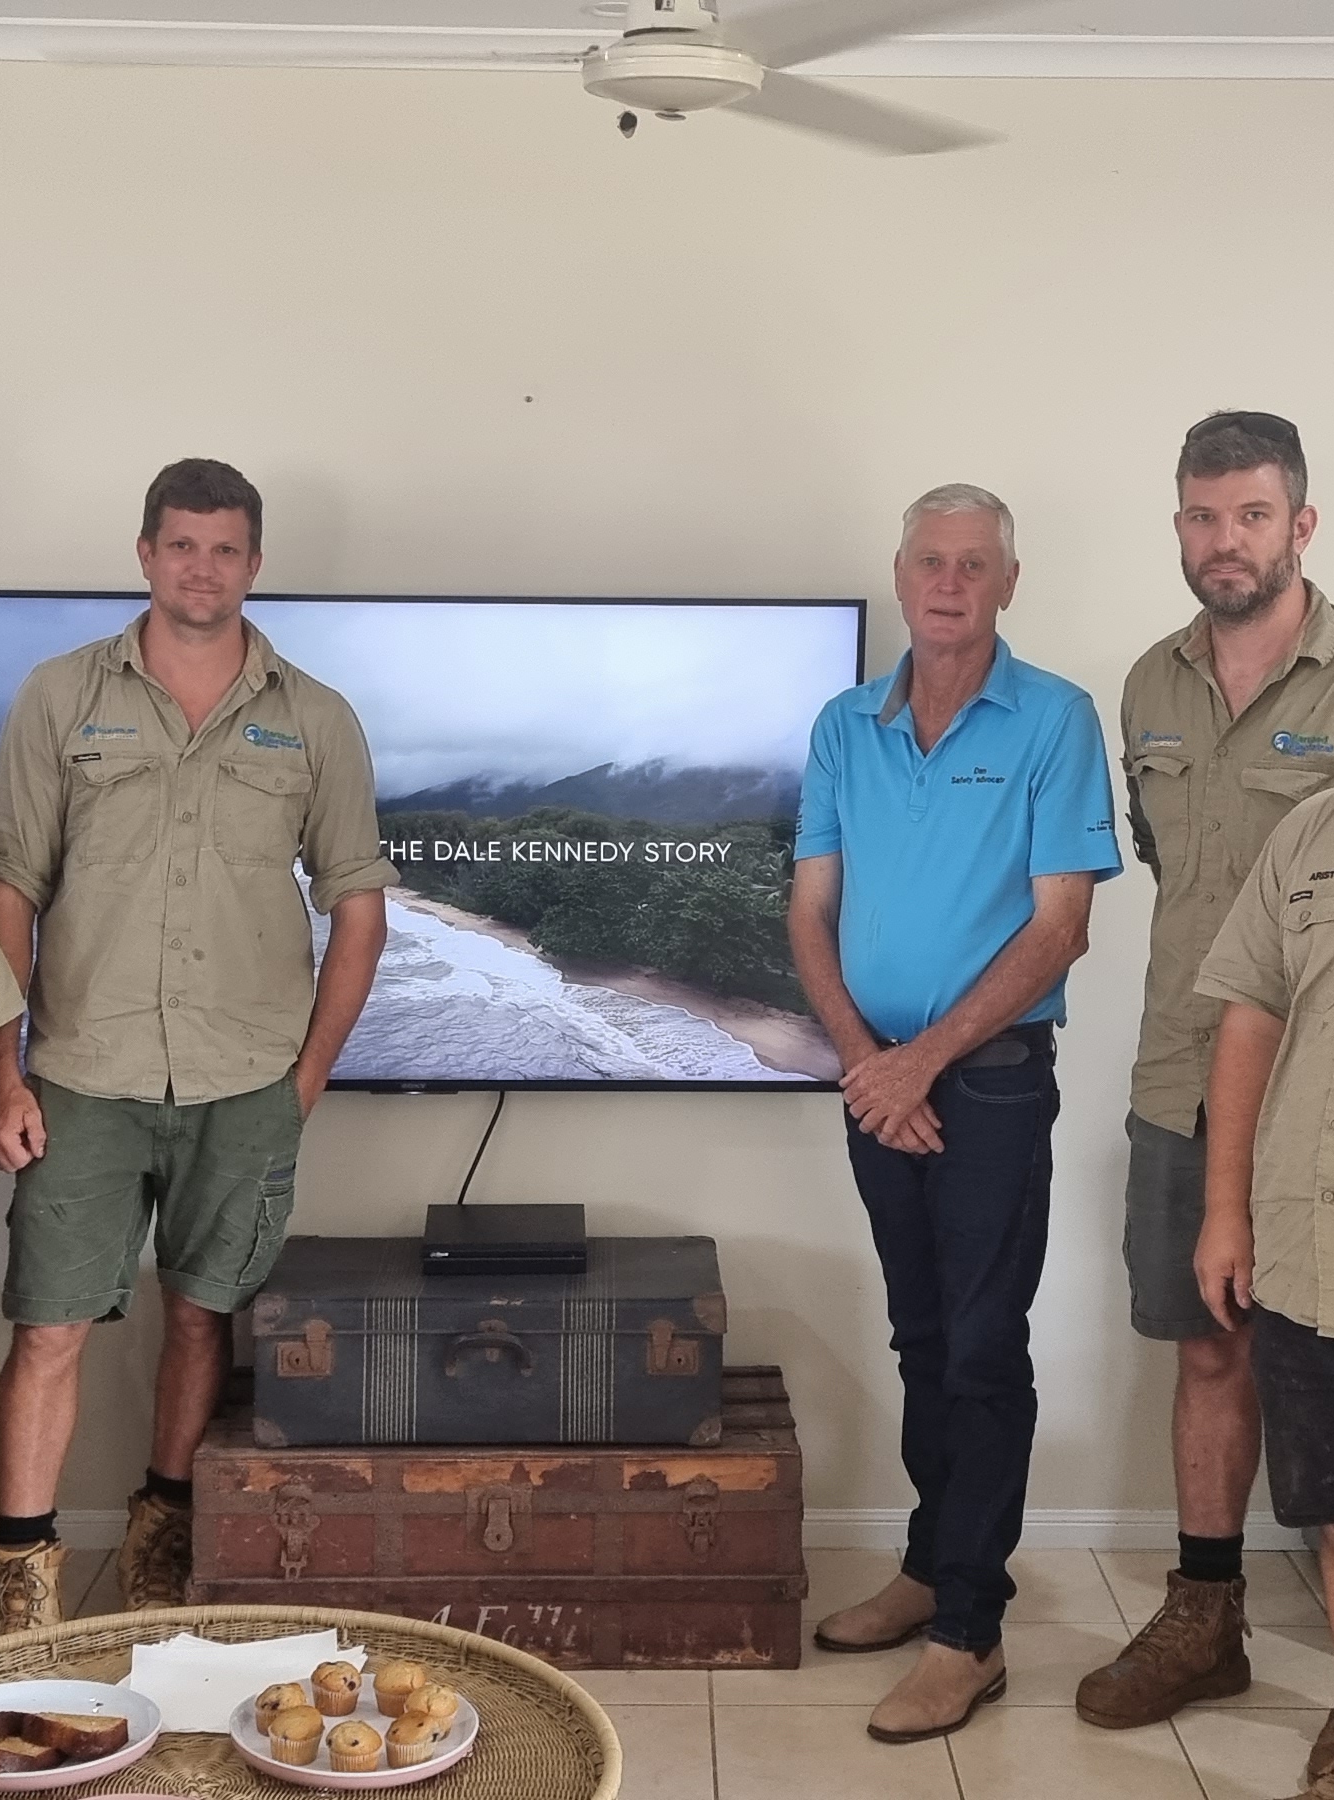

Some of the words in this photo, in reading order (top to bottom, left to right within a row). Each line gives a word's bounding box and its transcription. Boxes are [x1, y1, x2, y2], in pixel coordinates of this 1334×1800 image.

[951, 776, 973, 784] Safety
[380, 841, 424, 861] HE
[434, 841, 502, 861] DALE
[512, 841, 634, 862] KENNEDY
[644, 842, 732, 863] STORY
